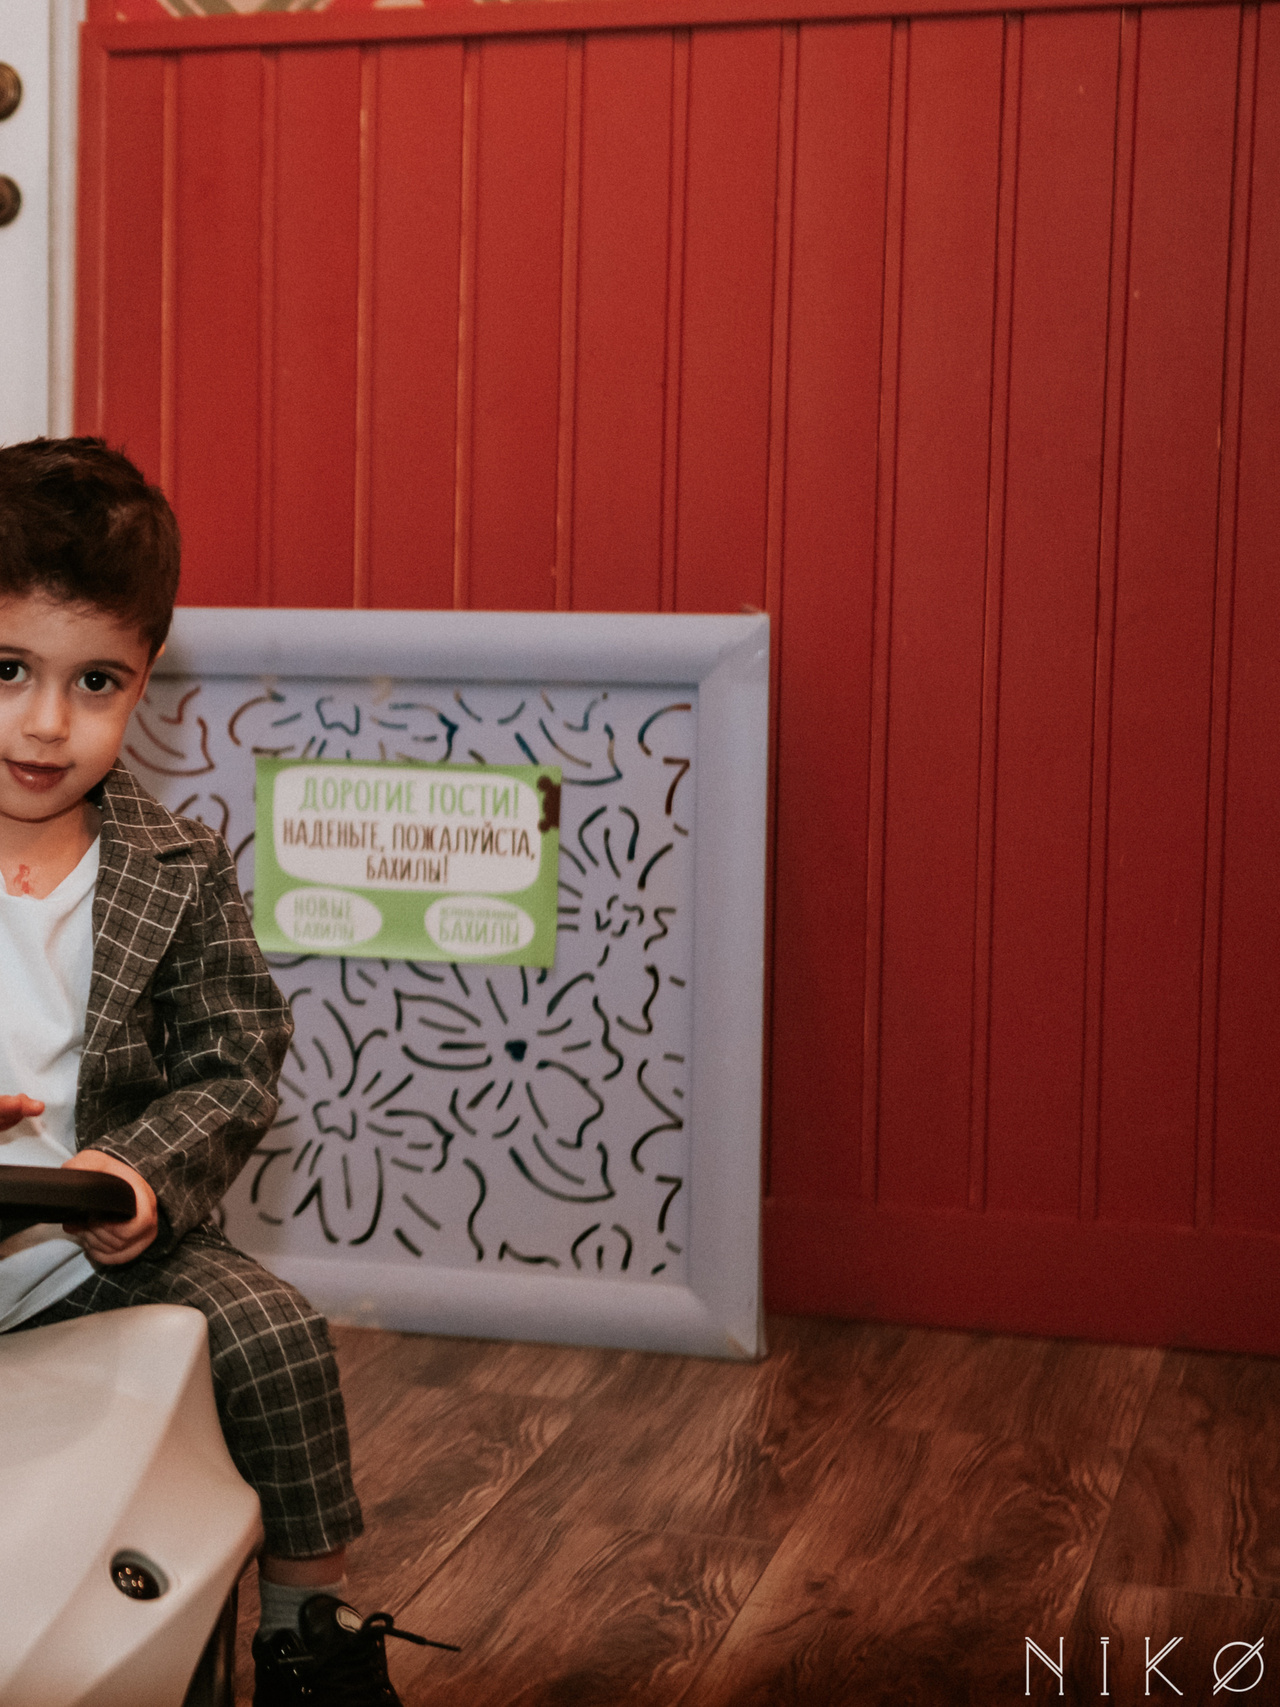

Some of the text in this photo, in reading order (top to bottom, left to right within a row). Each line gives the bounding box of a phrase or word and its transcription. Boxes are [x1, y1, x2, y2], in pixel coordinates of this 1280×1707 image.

[299, 776, 519, 819] ДОРОГИЕ ГОСТИ!
[283, 818, 535, 861] НАДЕНЬТЕ, ПОЖАЛУЙСТА,
[366, 854, 448, 883] БАХИЛЫ!
[439, 918, 519, 945] БАХИЛЫ
